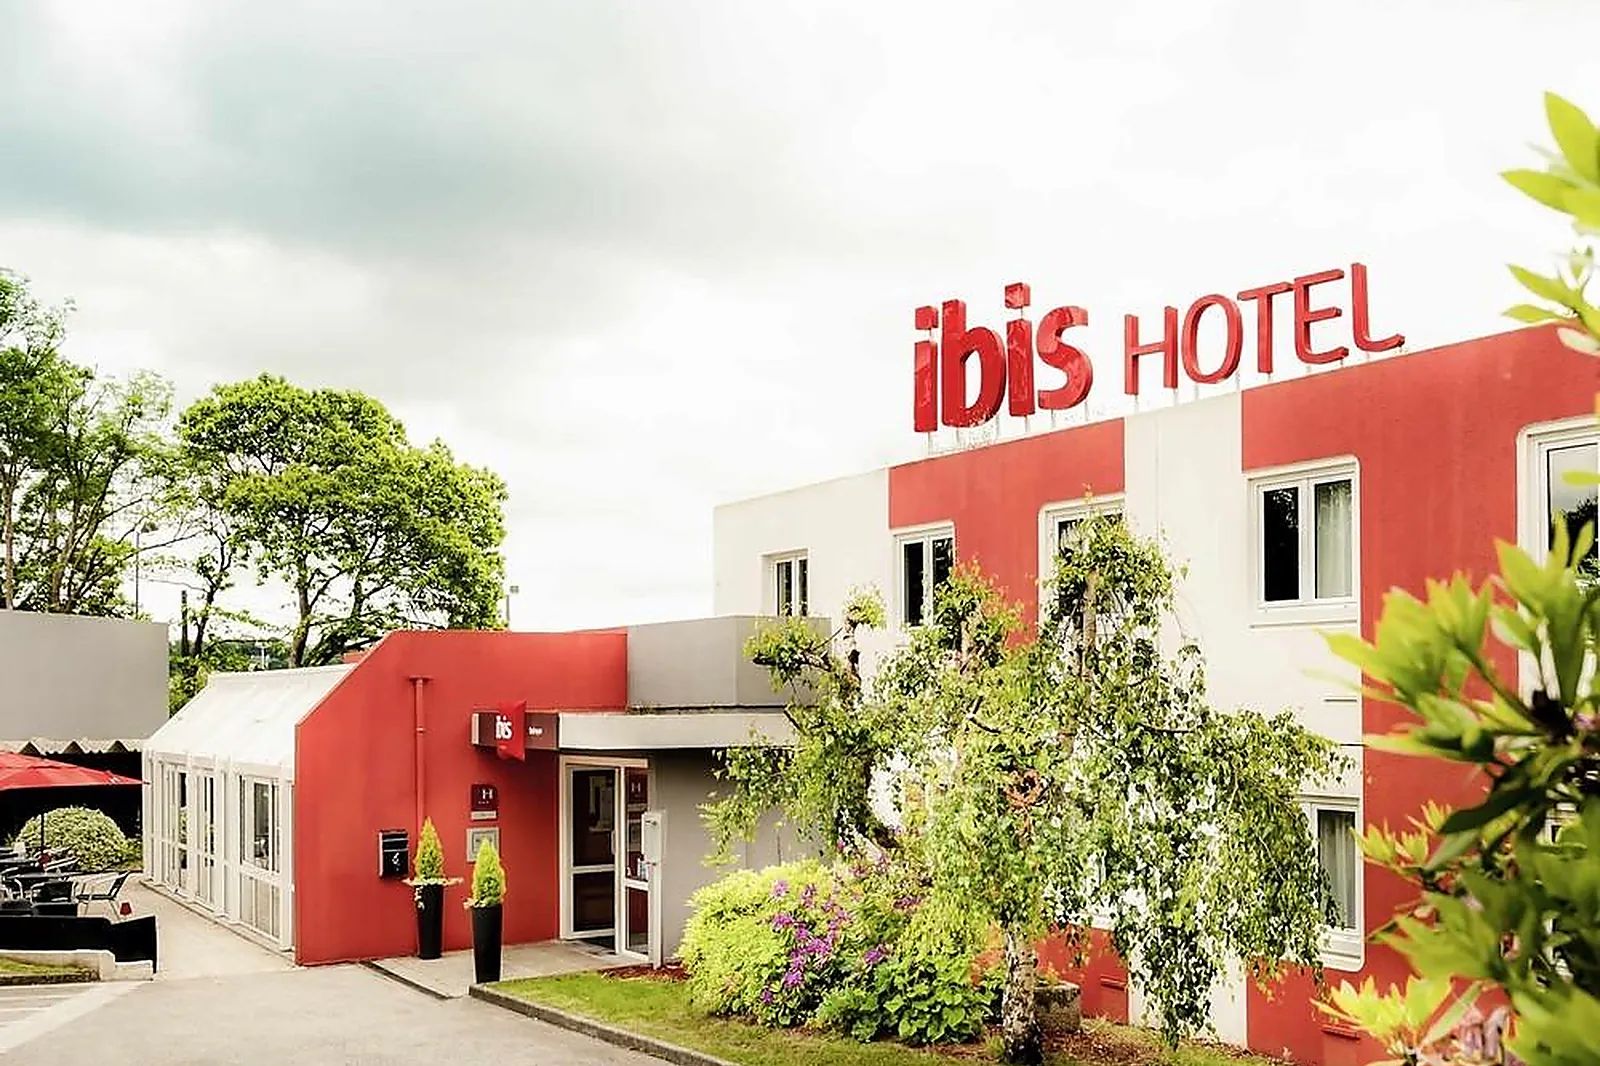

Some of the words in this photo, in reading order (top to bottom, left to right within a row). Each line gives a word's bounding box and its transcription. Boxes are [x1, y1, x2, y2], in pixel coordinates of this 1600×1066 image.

[913, 282, 1093, 433] ibis
[1124, 263, 1405, 395] HOTEL
[482, 789, 493, 799] H
